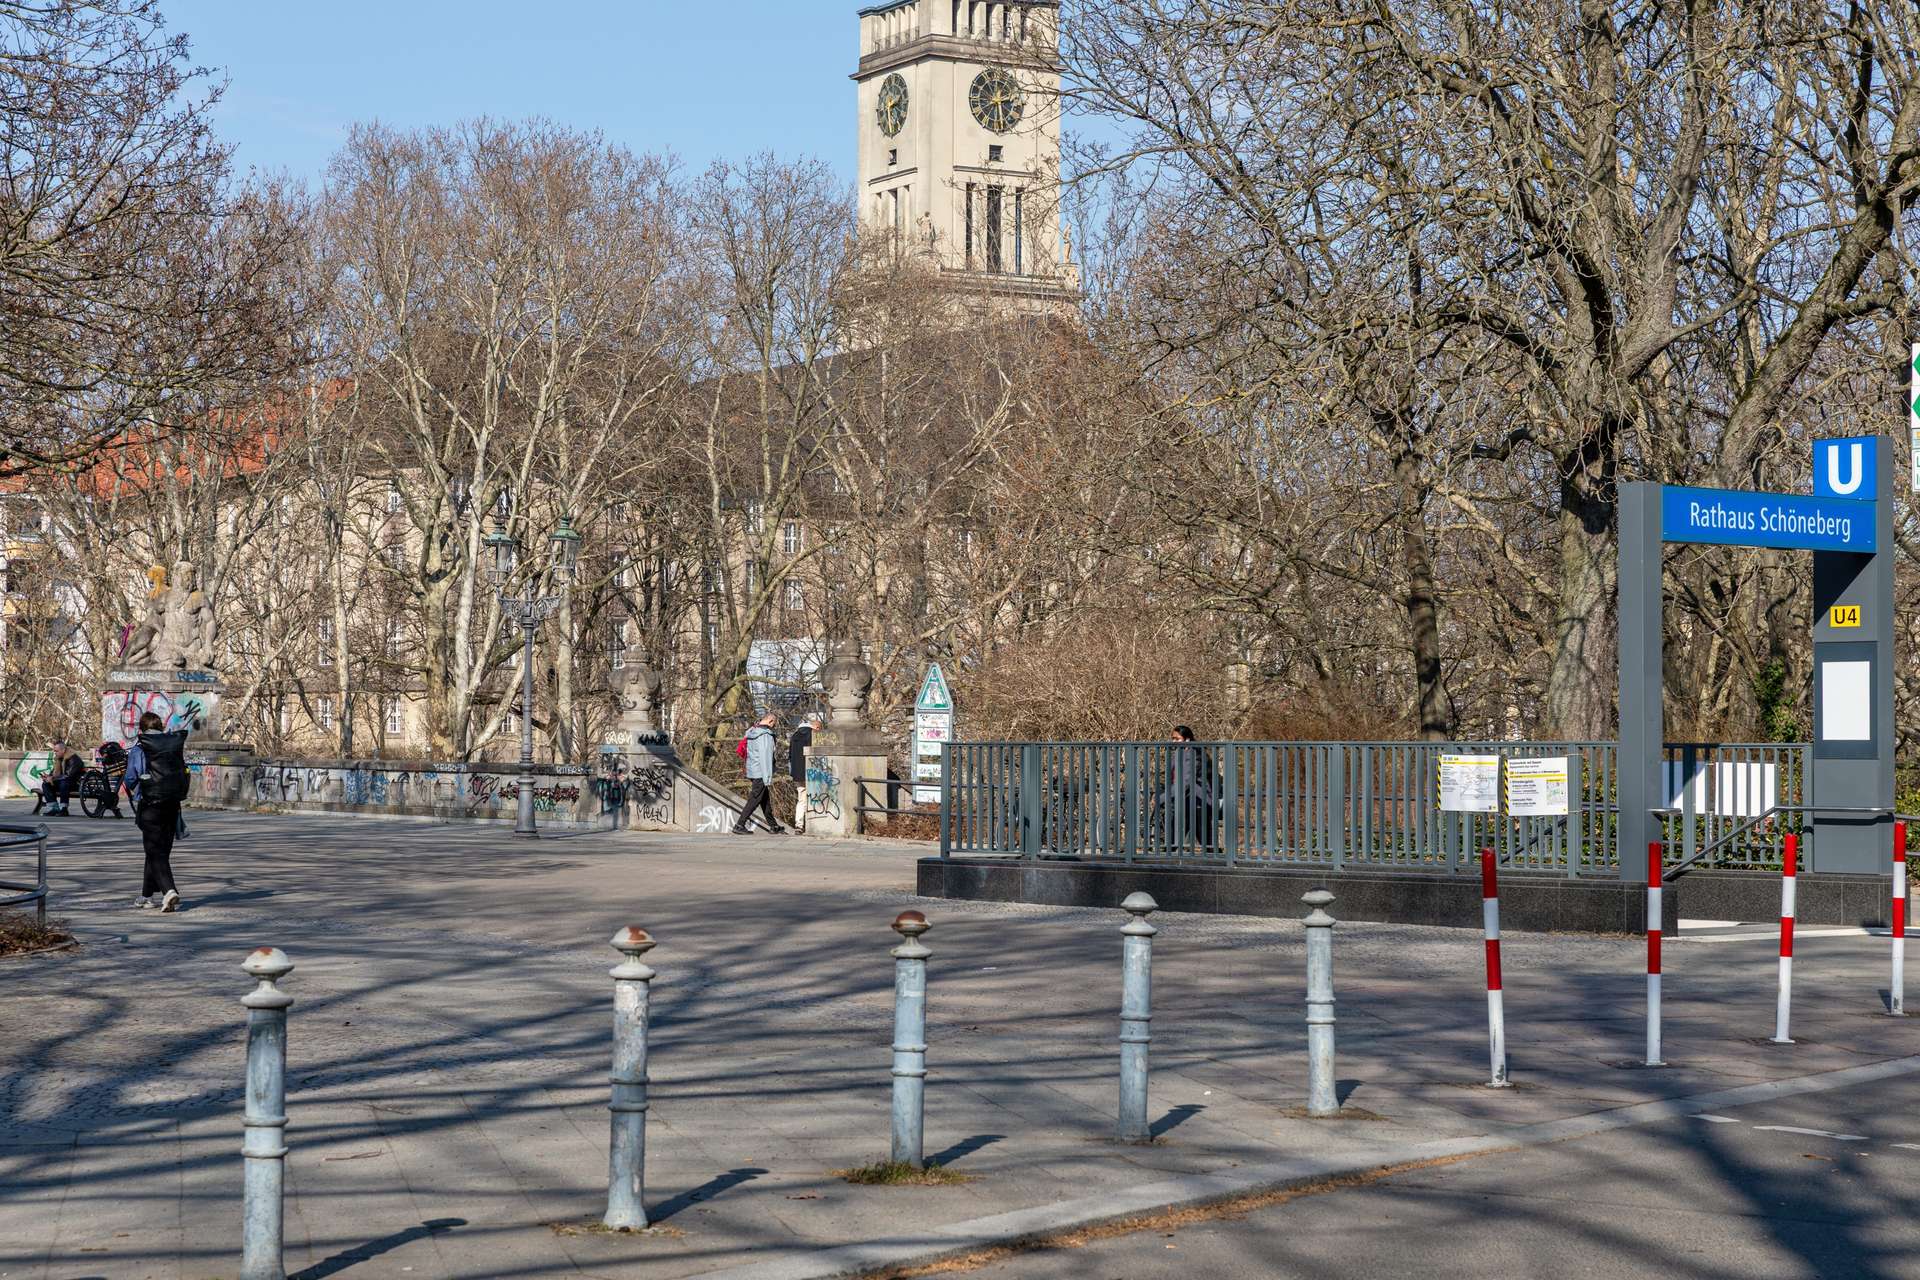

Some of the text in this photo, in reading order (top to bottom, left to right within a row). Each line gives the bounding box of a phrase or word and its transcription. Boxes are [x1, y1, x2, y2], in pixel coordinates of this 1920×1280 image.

[1827, 443, 1863, 495] U
[1690, 502, 1851, 543] Rathaus Schöneberg
[1834, 608, 1857, 624] U4
